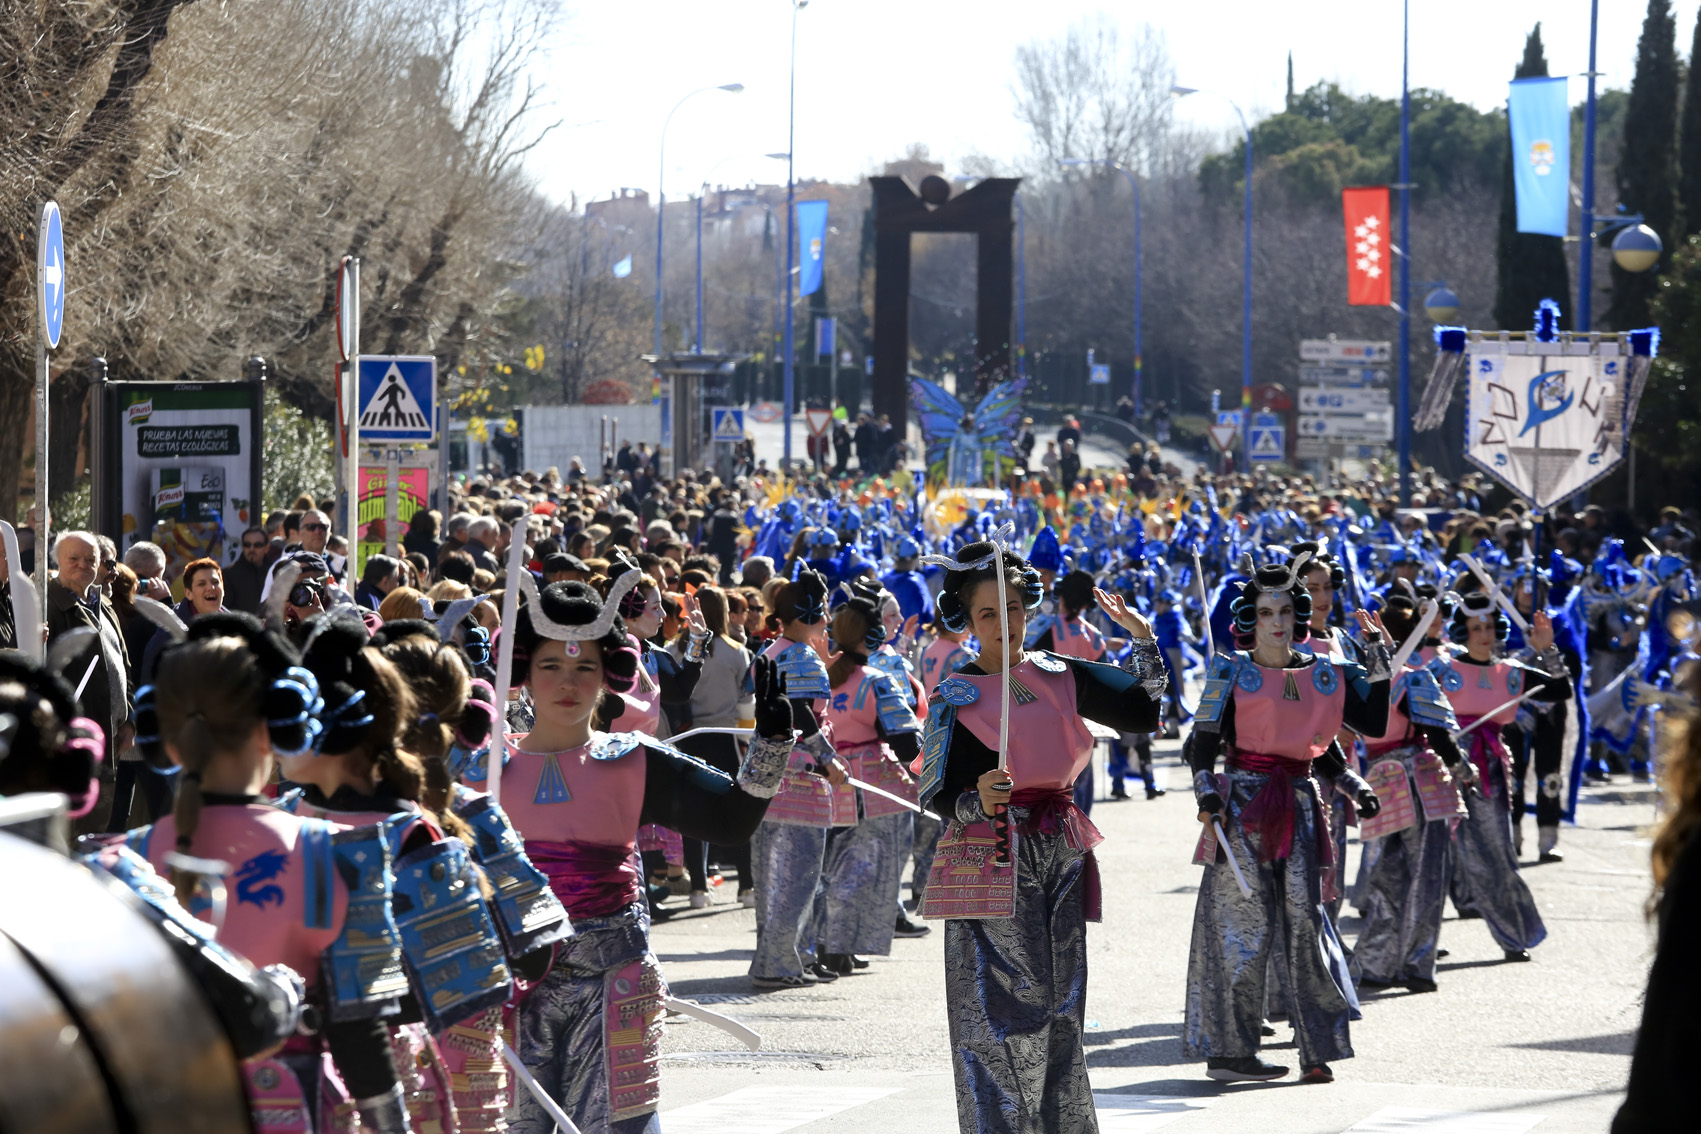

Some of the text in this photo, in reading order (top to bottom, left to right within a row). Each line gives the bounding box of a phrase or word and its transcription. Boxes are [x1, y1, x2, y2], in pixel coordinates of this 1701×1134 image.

[129, 404, 151, 417] Knorr
[143, 428, 228, 440] PRUEBA LAS NUEVAS
[142, 440, 229, 453] RECETAS ECOLÓGICAS
[157, 489, 183, 504] Knorr
